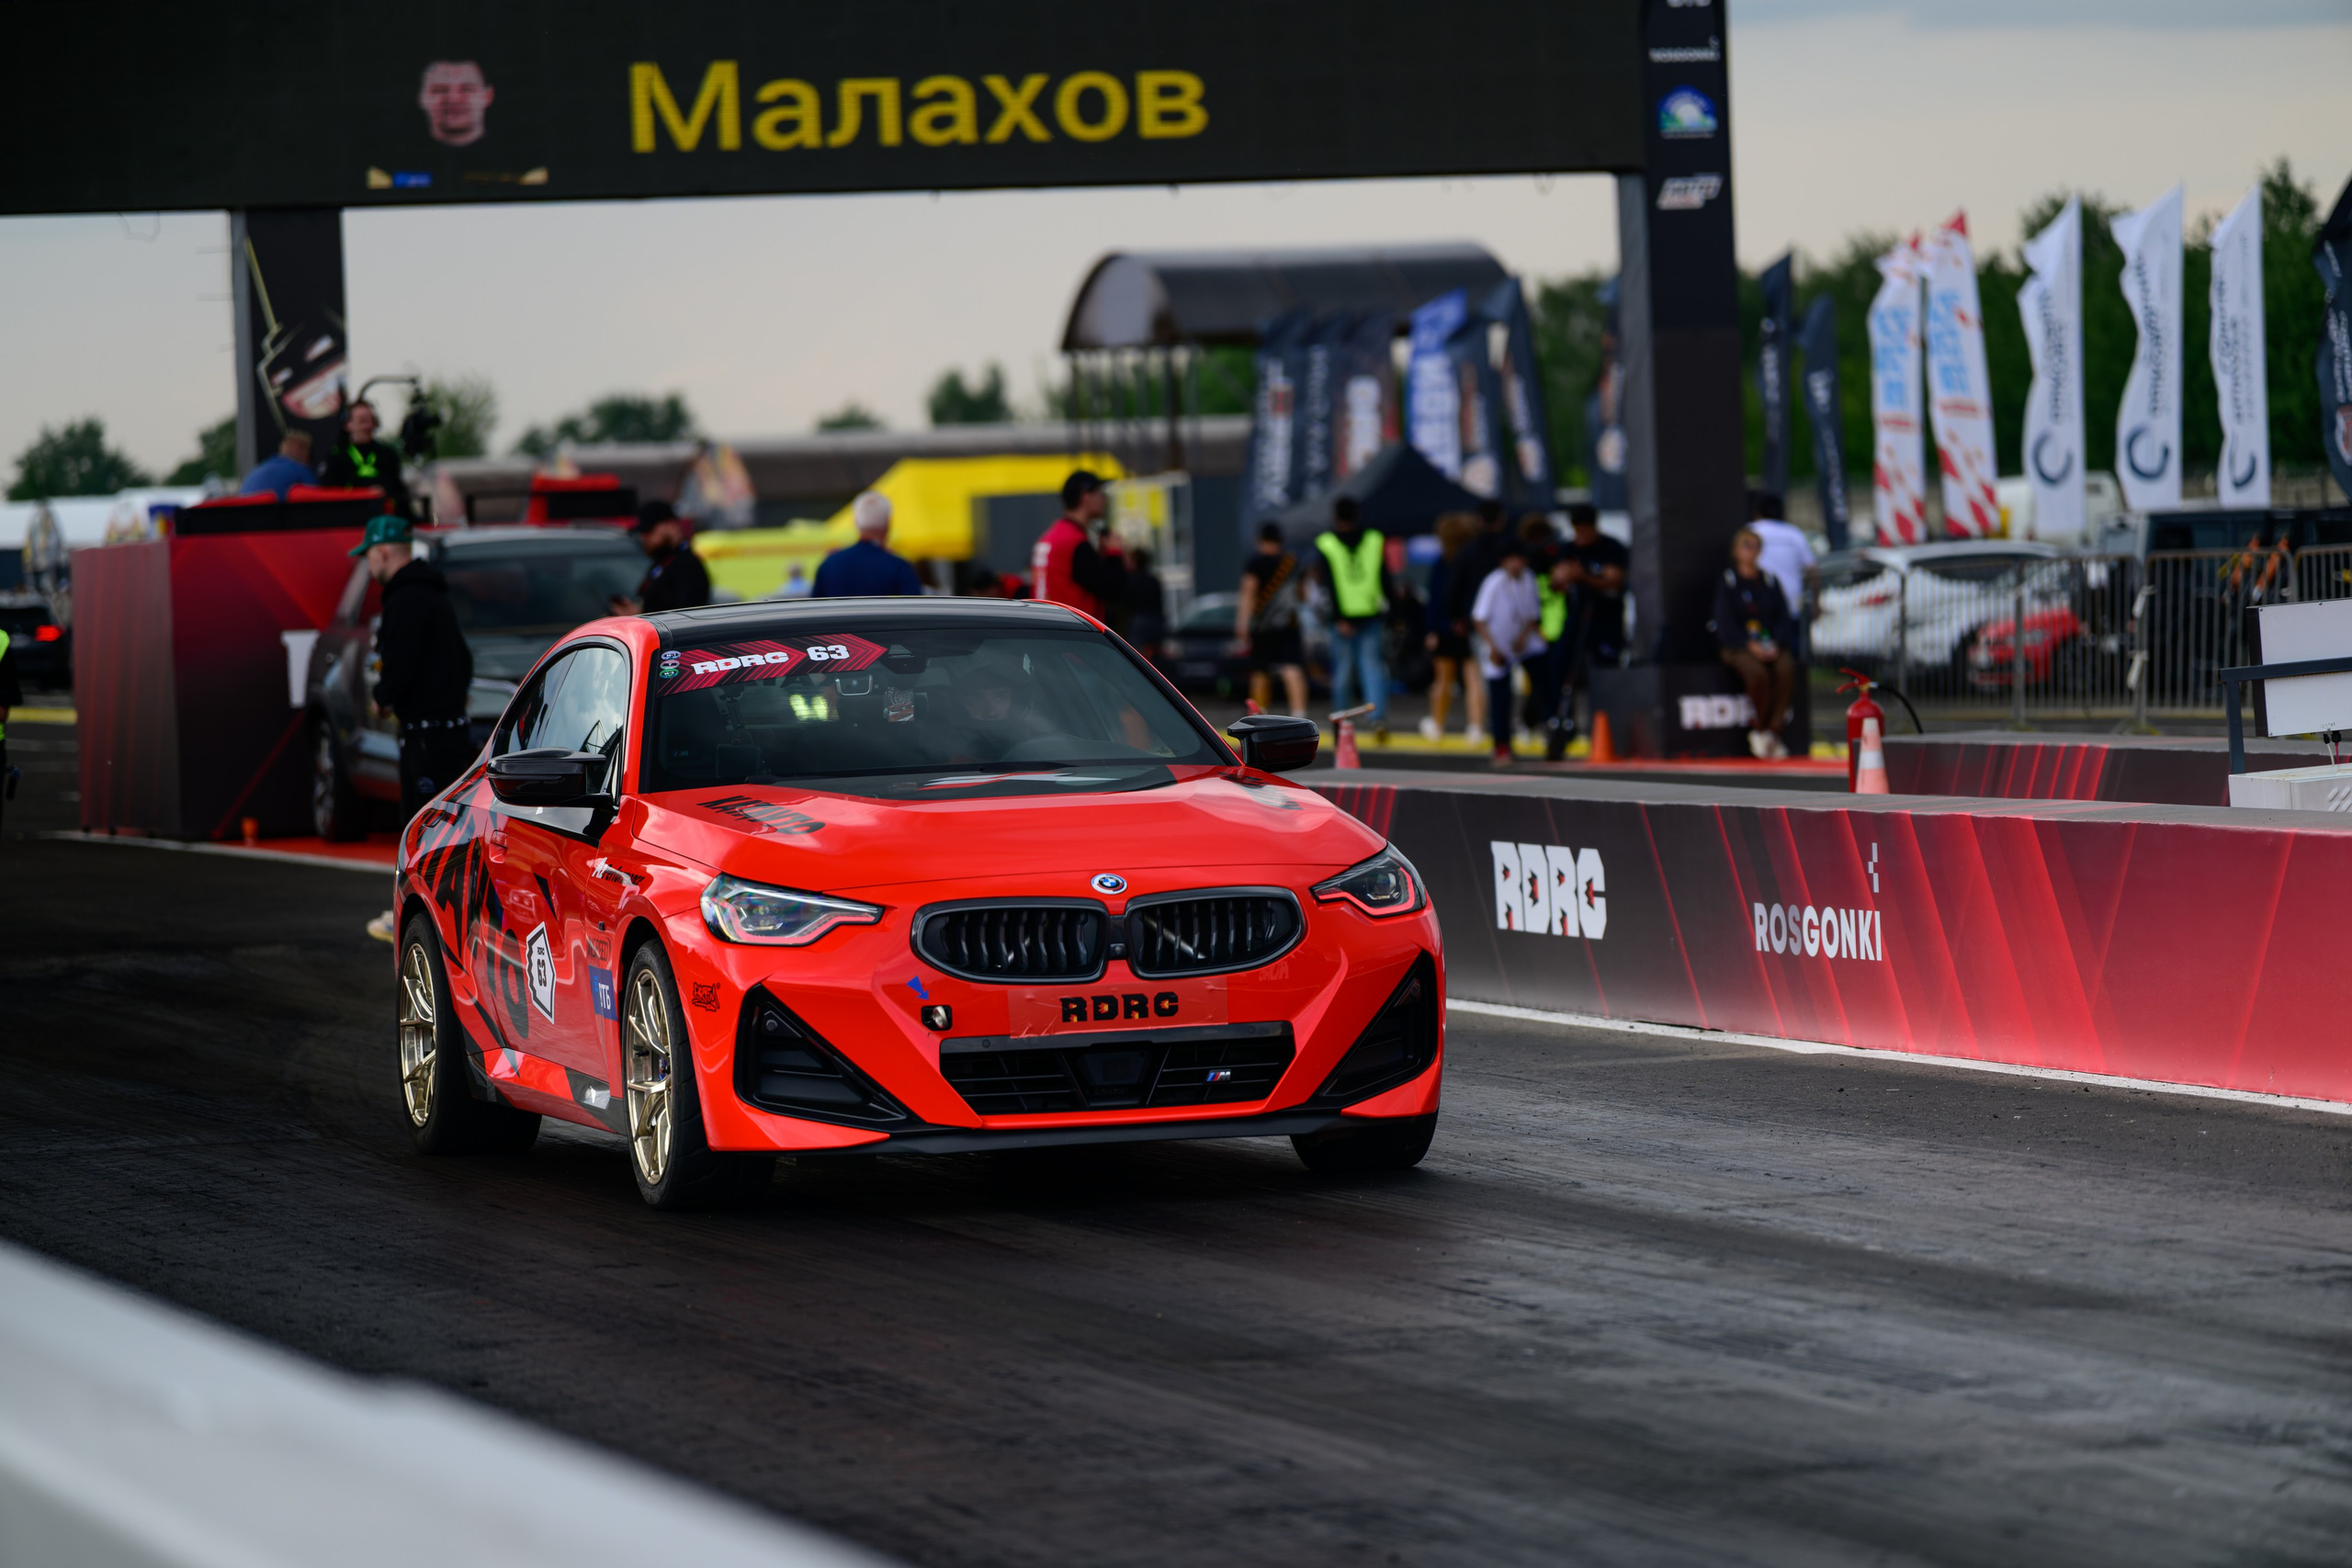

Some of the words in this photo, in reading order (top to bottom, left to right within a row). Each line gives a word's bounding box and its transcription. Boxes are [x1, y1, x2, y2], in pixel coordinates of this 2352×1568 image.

[628, 59, 1209, 152] Малахов
[690, 651, 789, 675] RDRC
[806, 644, 850, 661] 63
[1490, 840, 1608, 940] RDRC
[1753, 902, 1883, 962] ROSGONKI
[537, 959, 547, 987] 63
[1059, 991, 1179, 1023] RDRC
